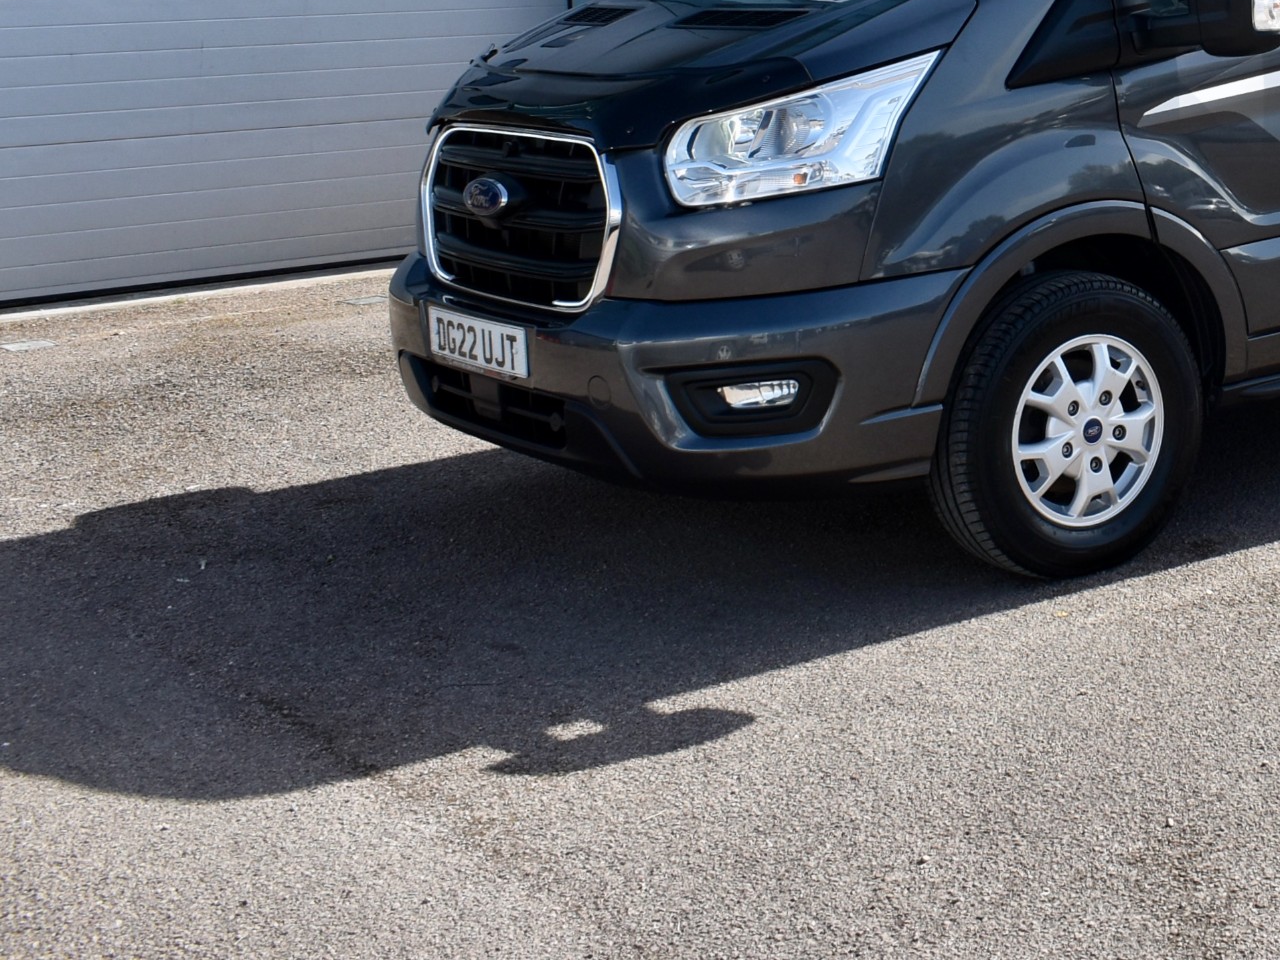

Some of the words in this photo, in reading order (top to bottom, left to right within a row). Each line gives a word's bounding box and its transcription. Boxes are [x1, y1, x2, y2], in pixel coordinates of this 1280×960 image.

[471, 183, 492, 208] Ford
[436, 316, 479, 361] DG22
[482, 328, 517, 371] UJT
